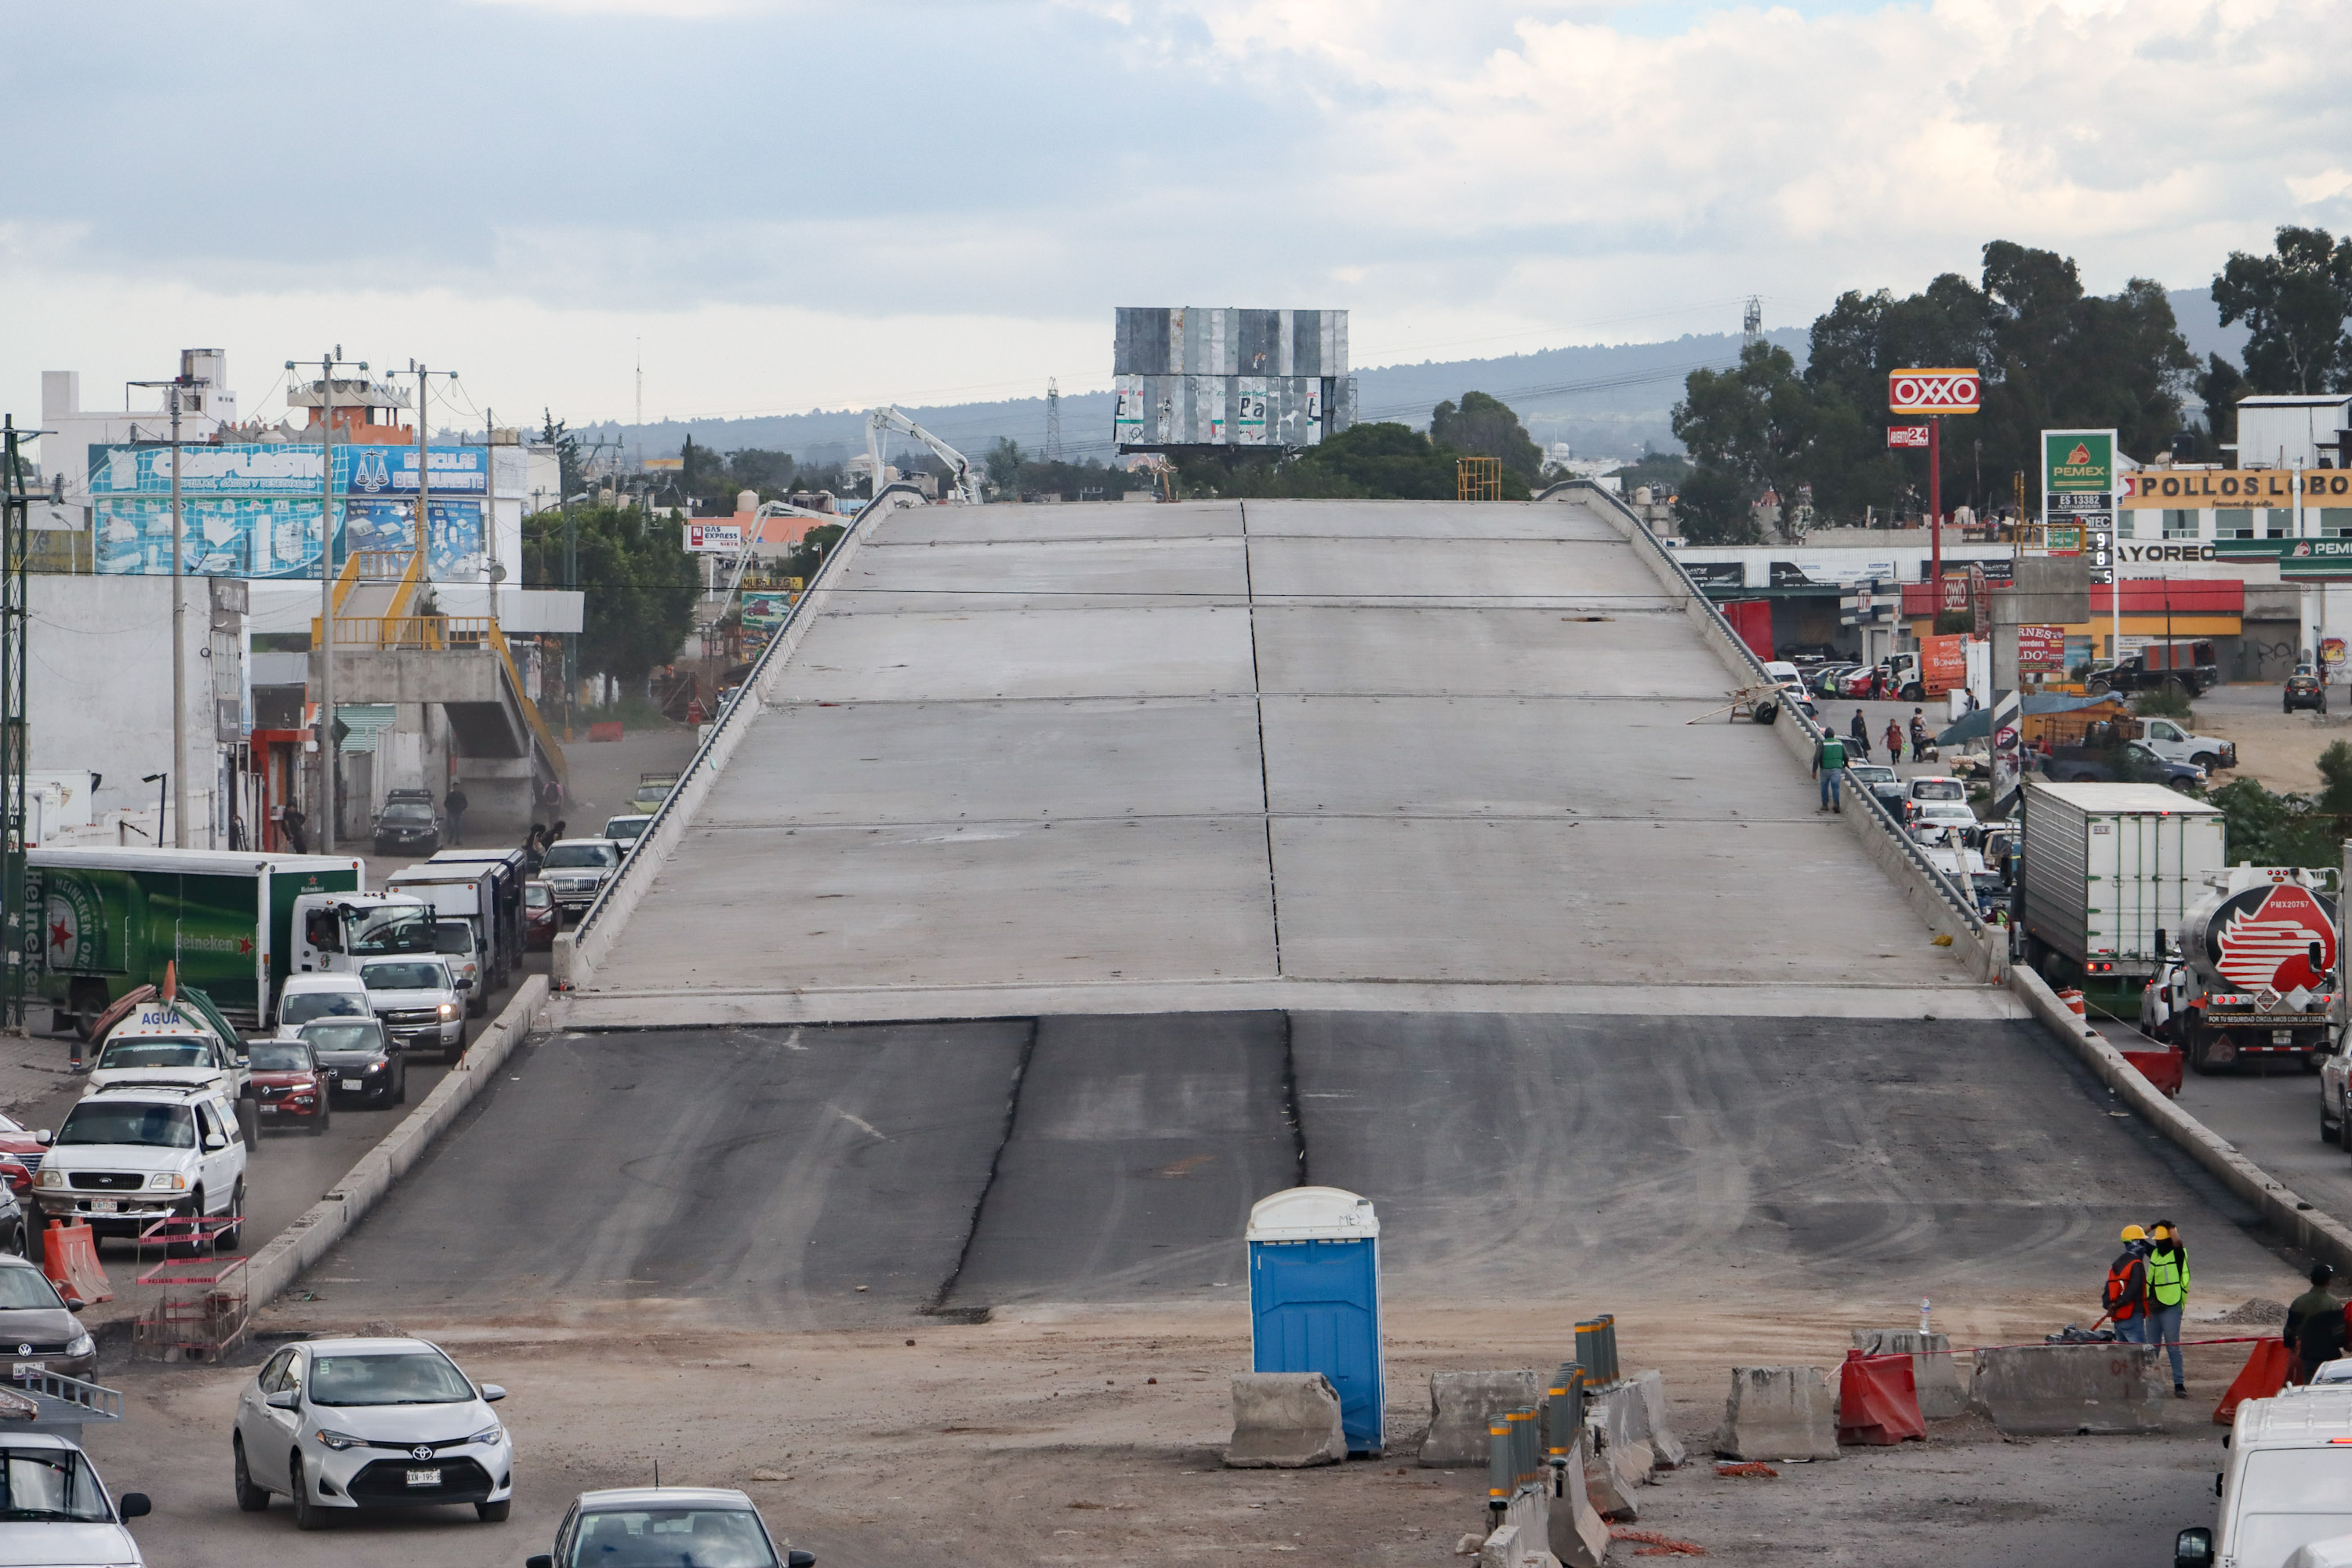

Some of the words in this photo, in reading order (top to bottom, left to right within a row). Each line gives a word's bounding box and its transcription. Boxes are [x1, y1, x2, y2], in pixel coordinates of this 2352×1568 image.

[1895, 378, 1976, 405] OXXO
[1909, 429, 1927, 440] 24
[2053, 466, 2104, 476] PEMEX
[177, 479, 218, 489] RPILLAS,
[220, 479, 250, 489] SACOS
[251, 480, 260, 489] Y
[260, 479, 316, 489] DESECHABLES
[2142, 477, 2259, 496] POLLOS
[2060, 495, 2071, 505] ES
[2074, 495, 2100, 505] 13382
[2314, 543, 2352, 554] PEM
[55, 878, 93, 935] HEINEKEN
[175, 933, 234, 952] Heineken
[142, 1012, 180, 1025] AGUA
